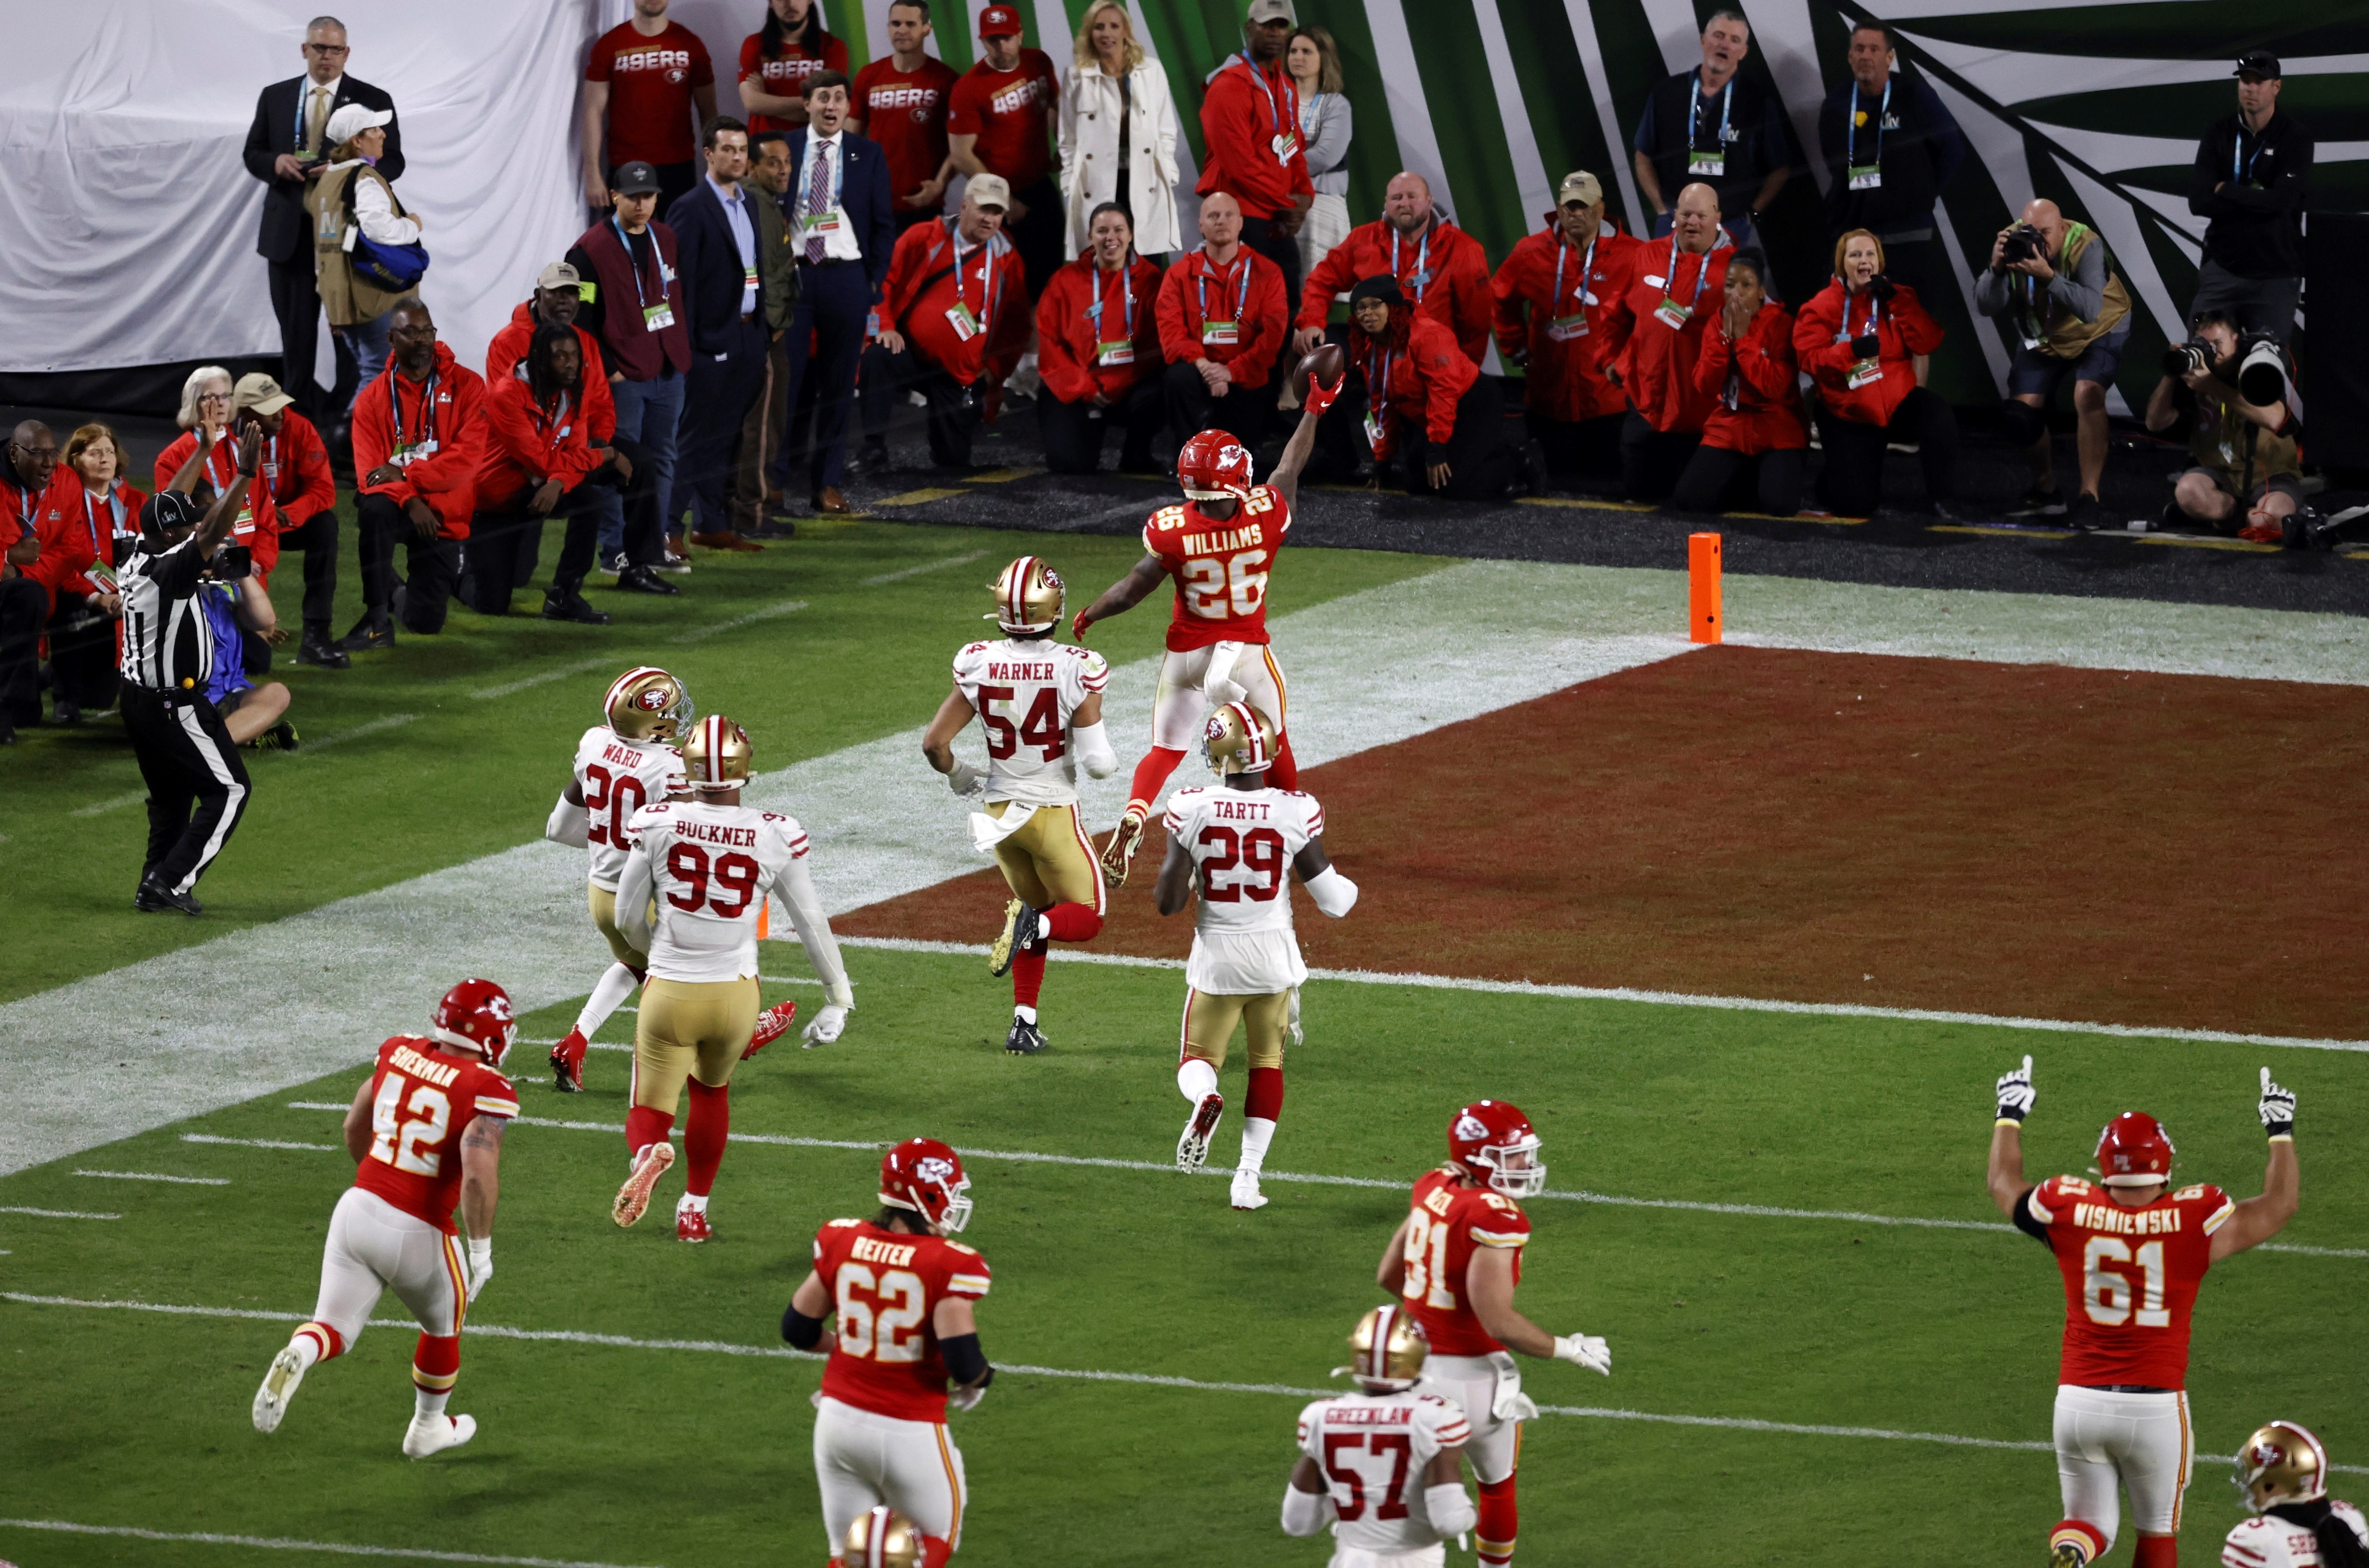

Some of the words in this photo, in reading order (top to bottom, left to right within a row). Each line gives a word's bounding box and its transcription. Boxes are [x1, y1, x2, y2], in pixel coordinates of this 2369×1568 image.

[614, 50, 690, 73] 49ERS
[869, 89, 938, 110] 49ERS
[1241, 487, 1274, 516] 26
[1157, 506, 1186, 532] 26
[1182, 524, 1263, 555] WILLIAMS
[1182, 549, 1268, 619] 26
[989, 663, 1054, 680] WARNER
[978, 685, 1065, 763] 54
[603, 744, 643, 768] WARD
[586, 763, 646, 852] 20
[1016, 802, 1032, 811] Wilson
[1214, 801, 1270, 820] TARTT
[675, 820, 756, 847] BUCKNER
[667, 842, 759, 918] 99
[1199, 826, 1284, 903] 29
[389, 1045, 461, 1088] SHERMAN
[369, 1071, 452, 1178] 42
[2074, 1202, 2181, 1235] WISNIEWSKI
[851, 1236, 917, 1267] REITER
[1403, 1207, 1457, 1311] 81
[2083, 1235, 2171, 1328] 61
[835, 1261, 926, 1363] 62
[1325, 1407, 1415, 1425] GREENLAW
[1324, 1432, 1412, 1521] 57
